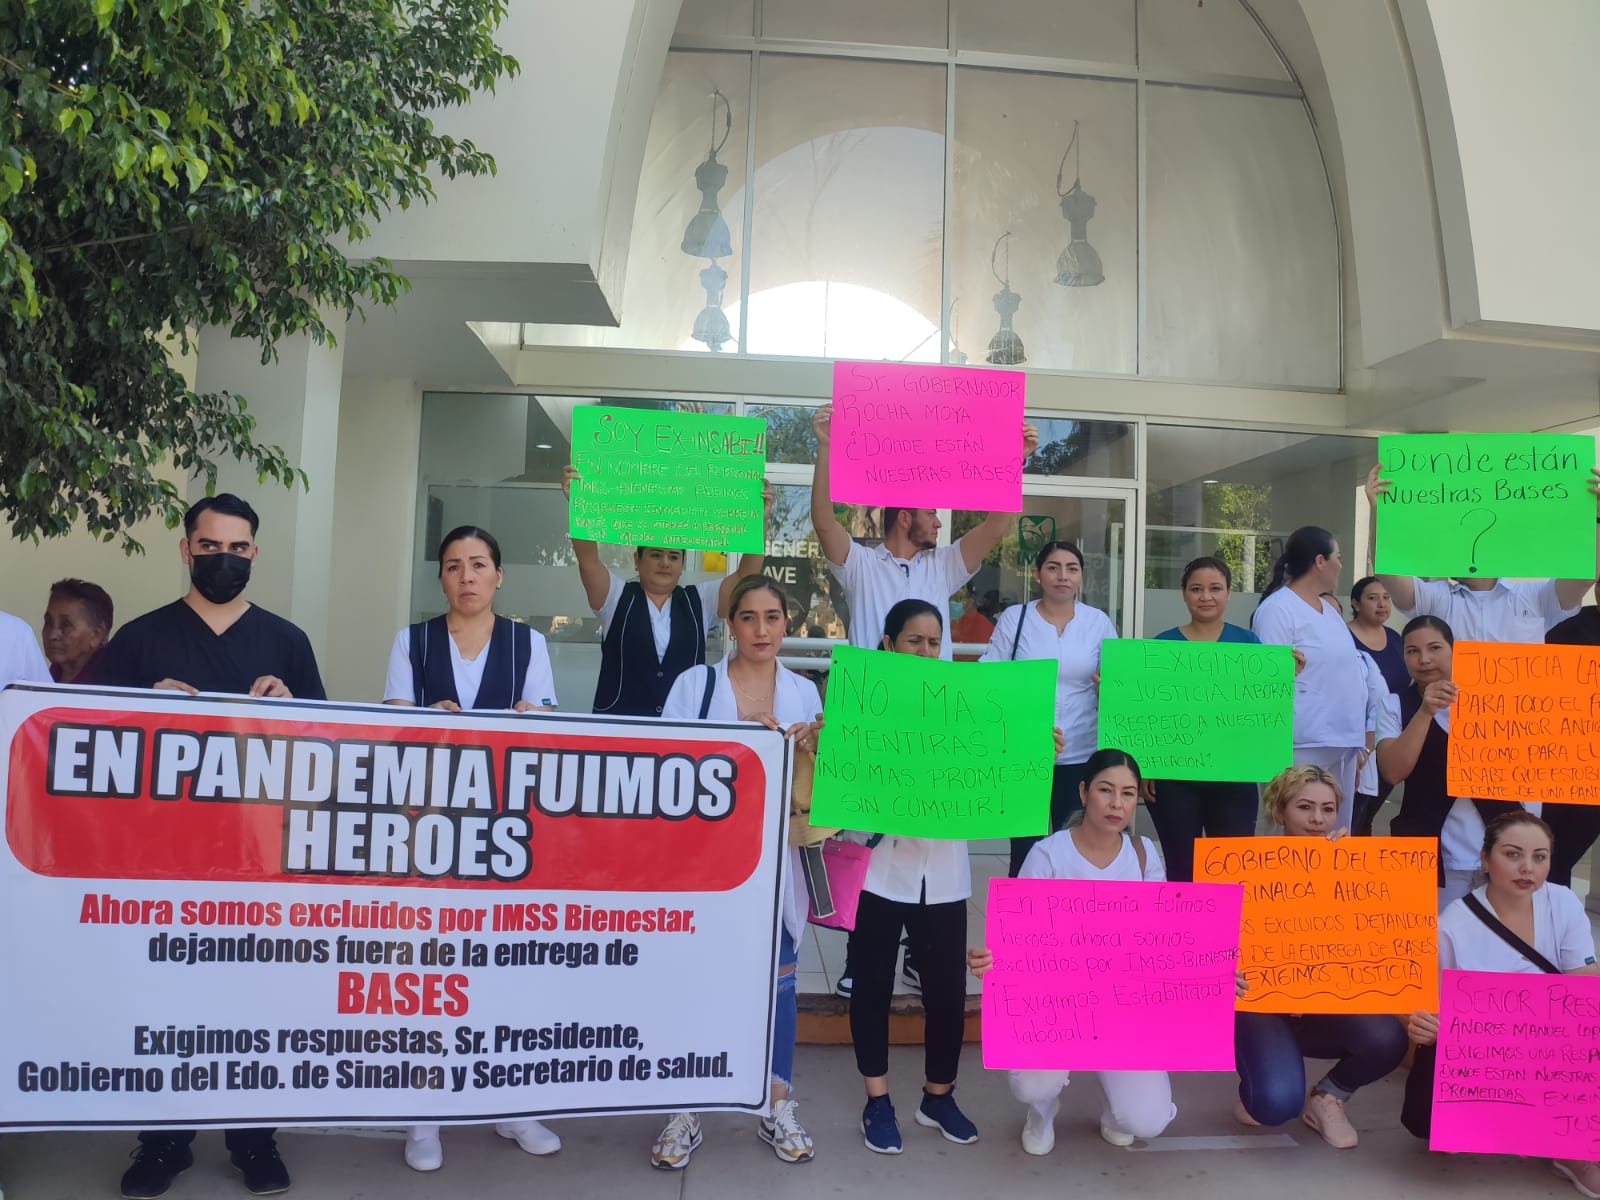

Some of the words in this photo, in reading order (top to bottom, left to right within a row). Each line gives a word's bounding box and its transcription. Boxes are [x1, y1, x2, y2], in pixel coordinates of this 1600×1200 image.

[852, 364, 891, 393] Sr.
[903, 371, 1020, 400] GOBERNADOR
[840, 394, 912, 427] ROCHA
[925, 403, 971, 424] MOYA
[594, 414, 644, 452] SOY
[935, 432, 985, 453] ESTÁN
[866, 464, 951, 483] NUESTRAS
[958, 457, 1022, 484] BASES?
[1505, 444, 1578, 471] están
[1383, 482, 1482, 504] Nuestras
[1495, 478, 1569, 501] Bases
[1460, 508, 1497, 573] ?
[1143, 642, 1280, 678] EXIGIMOS
[1457, 652, 1563, 687] JUSTICIA
[1577, 655, 1600, 688] LA
[1457, 691, 1505, 719] PARA
[1512, 695, 1554, 714] TODO
[1559, 696, 1584, 711] EL
[1198, 713, 1208, 729] A
[1216, 712, 1288, 729] NUESTRA
[1452, 720, 1488, 741] CON
[1494, 718, 1552, 741] MAYOR
[1452, 743, 1475, 763] ASI
[1480, 746, 1520, 763] COMO
[1528, 742, 1569, 762] PARA
[50, 725, 142, 797] EN
[154, 731, 496, 812] PANDEMIA
[505, 749, 736, 820] FUIMOS
[868, 763, 916, 787] MAS
[927, 757, 1051, 790] PROMESAS
[1448, 766, 1505, 784] INSABI
[1512, 766, 1546, 783] QUE
[841, 793, 880, 814] SIN
[284, 808, 531, 879] HEROES
[1204, 846, 1321, 876] GOBIERNO
[1333, 849, 1375, 874] DEL
[1334, 881, 1391, 901] AHORA
[80, 894, 174, 925] Ahora
[181, 900, 282, 927] somos
[289, 899, 432, 930] excluidos
[439, 905, 487, 934] por
[492, 903, 558, 932] IMSS
[564, 904, 696, 934] Bienestar,
[996, 884, 1033, 915] En
[1048, 885, 1140, 928] pandemia
[1154, 887, 1217, 913] fuimos
[1070, 924, 1121, 947] ahora
[1133, 931, 1195, 947] somos
[1264, 915, 1345, 934] EXCLUIDOS
[149, 933, 329, 965] dejandonos
[336, 935, 414, 966] fuera
[420, 938, 456, 967] de
[462, 939, 488, 967] la
[494, 940, 599, 968] entrega
[605, 939, 639, 966] de
[1251, 944, 1275, 962] DE
[1281, 942, 1296, 960] LA
[1300, 943, 1362, 960] ENTREGA
[1368, 942, 1389, 956] DE
[1392, 937, 1437, 957] BASES
[1086, 957, 1113, 981] por
[1243, 965, 1332, 990] EXIGIMOS
[1336, 963, 1420, 991] JUSTICIA
[338, 971, 469, 1017] BASES
[1113, 980, 1222, 1006] Estabilidad
[134, 1025, 270, 1058] Exigimos
[277, 1027, 449, 1057] respuestas,
[455, 1026, 488, 1054] Sr.
[494, 1022, 644, 1053] Presidente,
[1450, 1016, 1508, 1042] ANDRES
[1513, 1022, 1569, 1041] MANUEL
[1445, 1045, 1523, 1063] EXIGIMOS
[1528, 1046, 1555, 1060] UNA
[1561, 1043, 1600, 1065] RESP
[18, 1061, 164, 1092] Gobierno
[171, 1061, 219, 1091] del
[226, 1061, 286, 1090] Edo.
[292, 1060, 329, 1089] de
[336, 1059, 445, 1089] Sinaloa
[451, 1066, 467, 1092] y
[473, 1056, 612, 1089] Secretario
[618, 1055, 651, 1081] de
[657, 1052, 733, 1079] salud.
[1440, 1064, 1481, 1079] DONDE
[1485, 1067, 1526, 1081] ESTAN
[1535, 1066, 1598, 1083] NUESTRAS
[1440, 1082, 1528, 1101] PROMETIDAS
